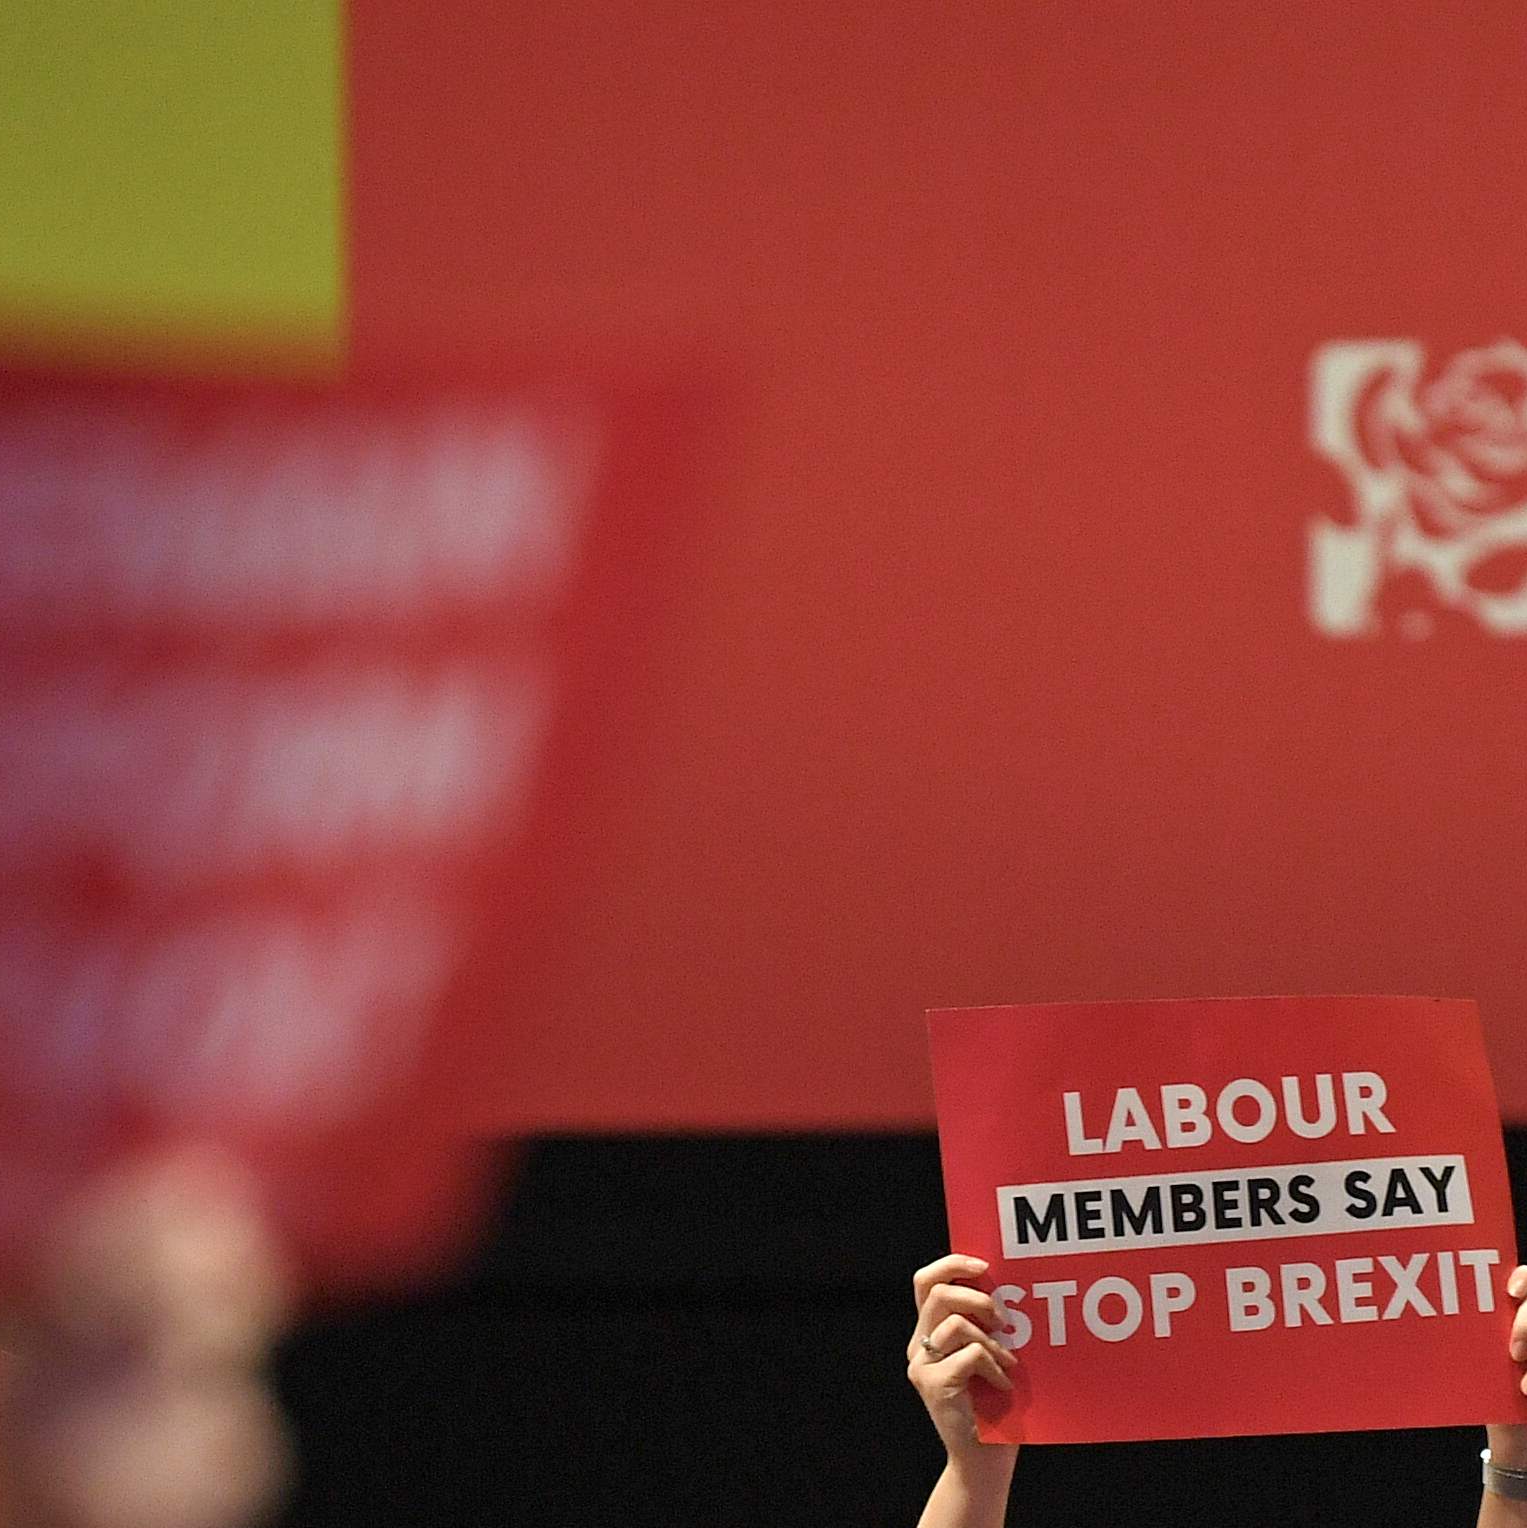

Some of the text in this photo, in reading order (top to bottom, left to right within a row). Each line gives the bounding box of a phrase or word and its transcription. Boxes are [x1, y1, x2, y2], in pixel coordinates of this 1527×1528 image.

[1062, 1071, 1395, 1155] LABOUR
[1013, 1165, 1456, 1245] MEMBERS SAY
[991, 1248, 1500, 1351] STOP BREXIT
